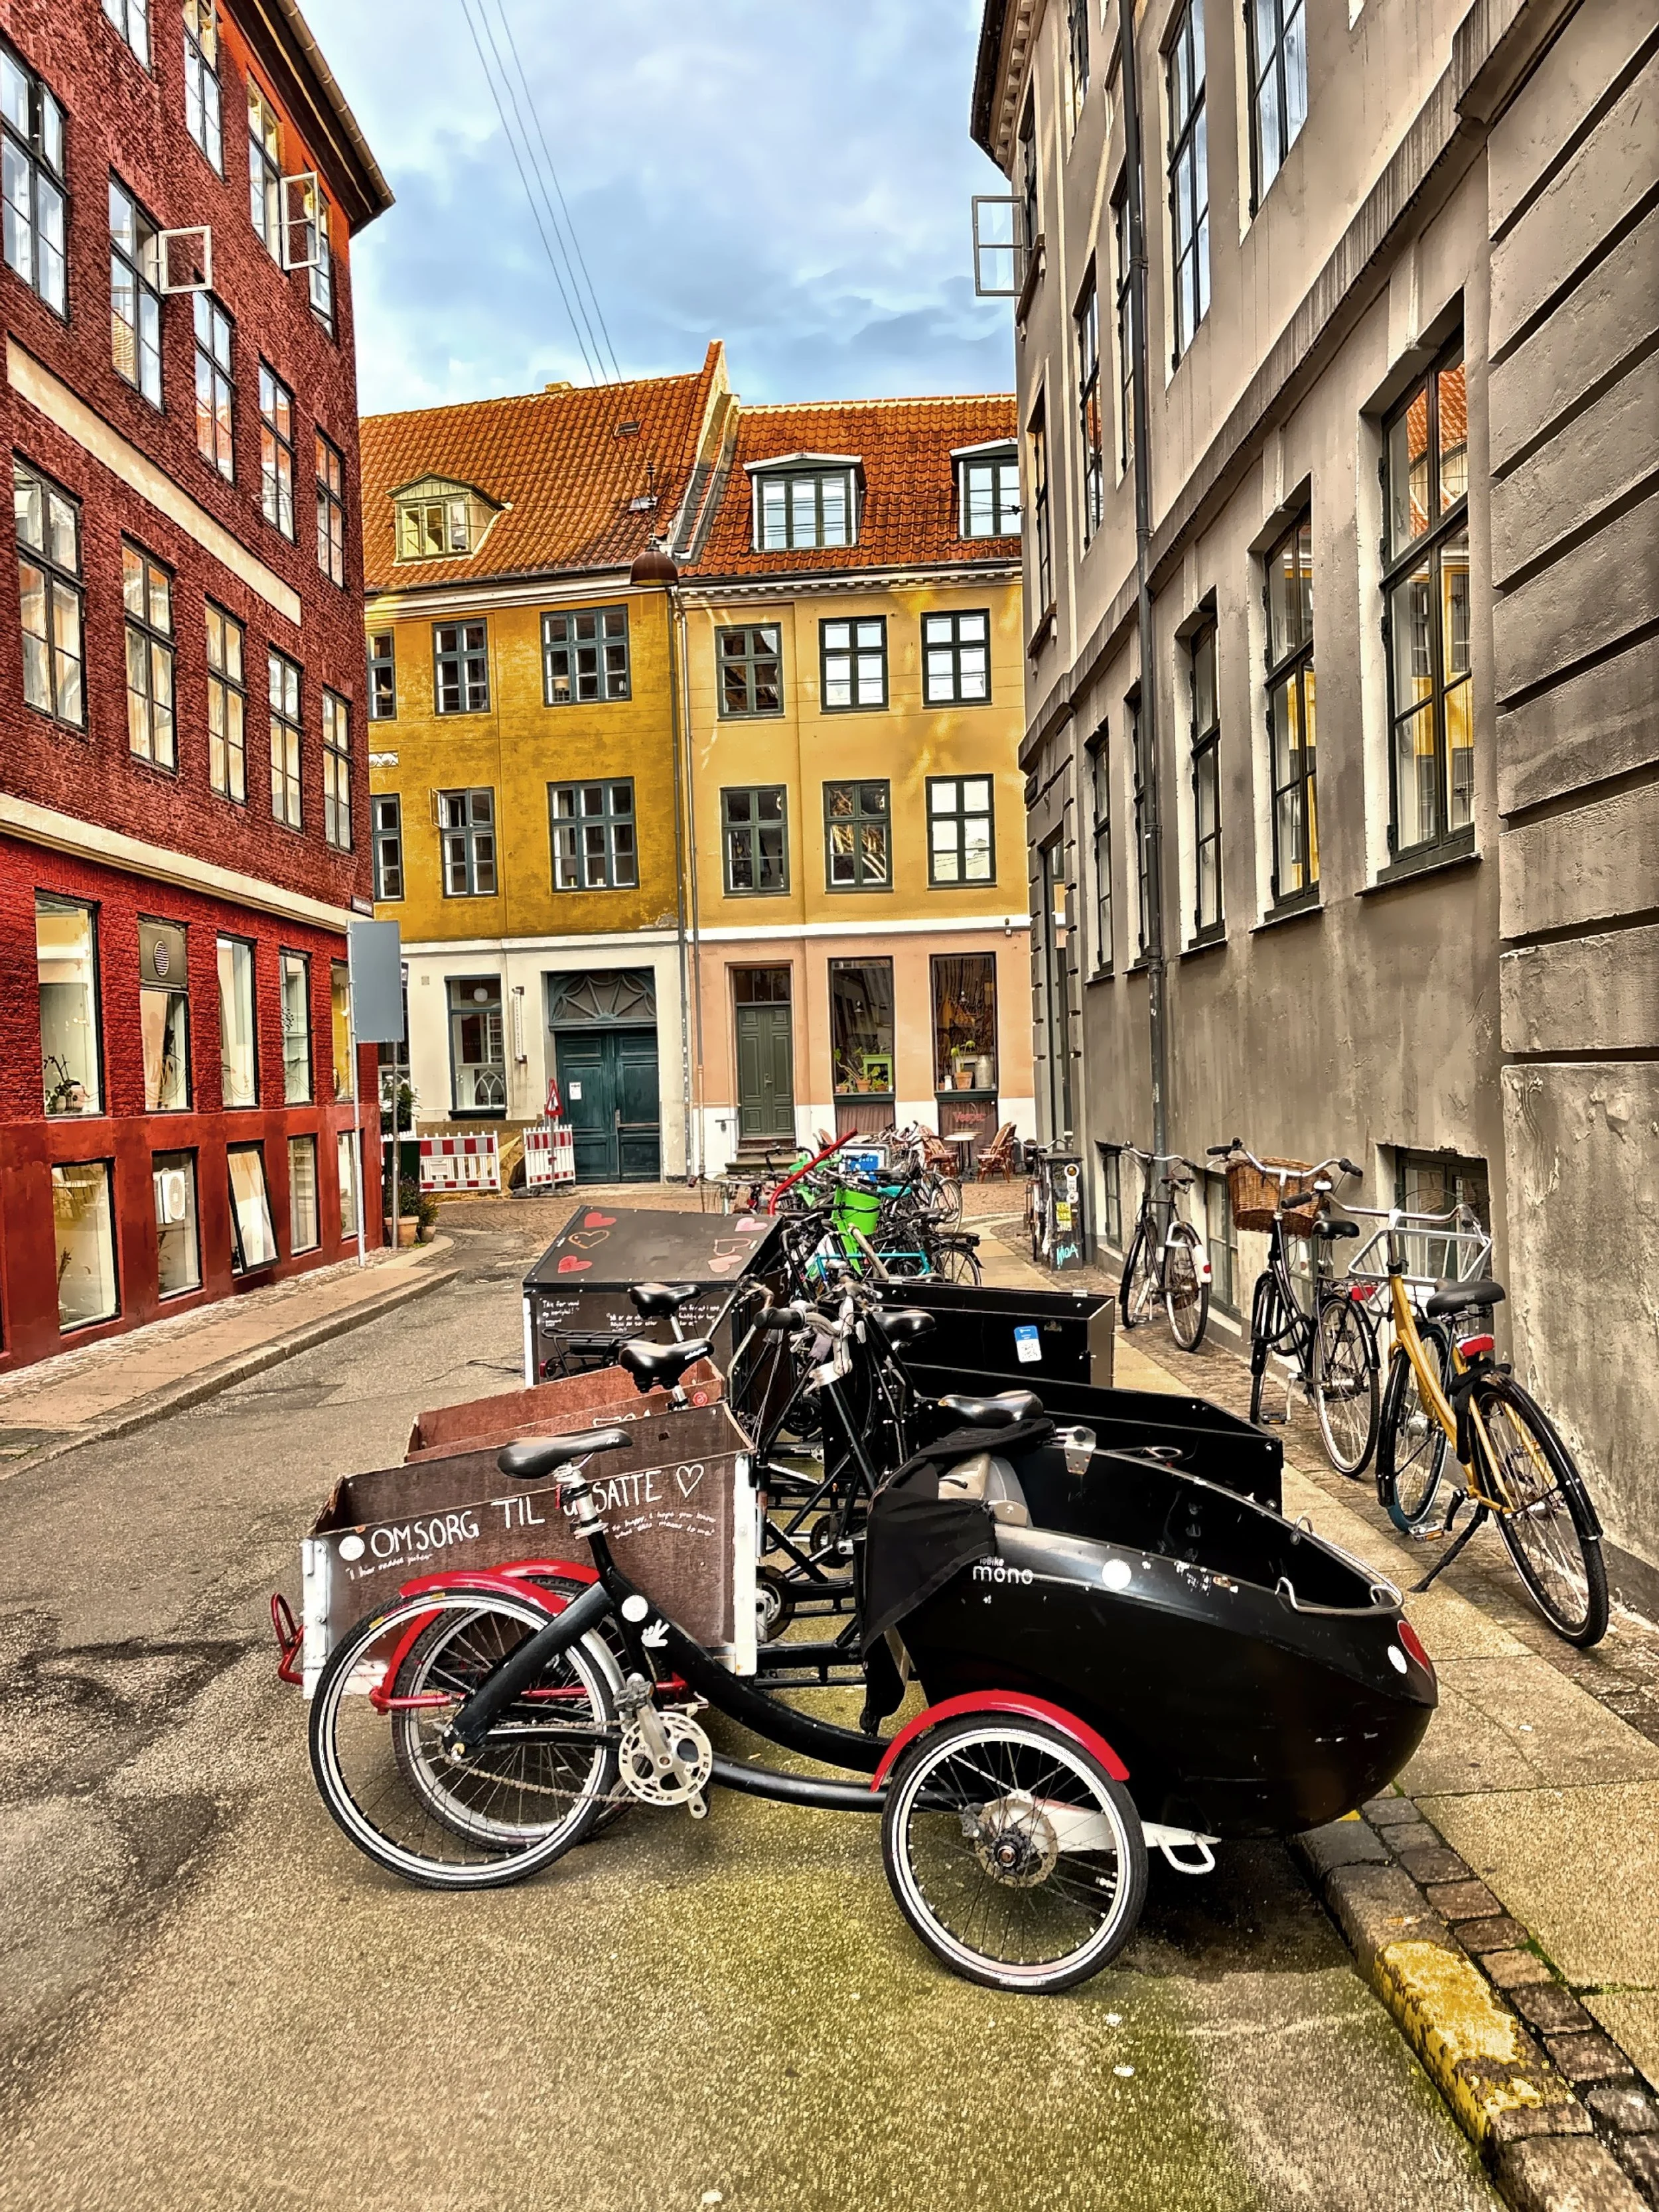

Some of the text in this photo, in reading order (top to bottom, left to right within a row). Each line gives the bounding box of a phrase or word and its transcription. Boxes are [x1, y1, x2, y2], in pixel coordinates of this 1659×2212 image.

[370, 1510, 480, 1558] OMSORG
[490, 1496, 545, 1529] TIL
[972, 1565, 1033, 1585] mono
